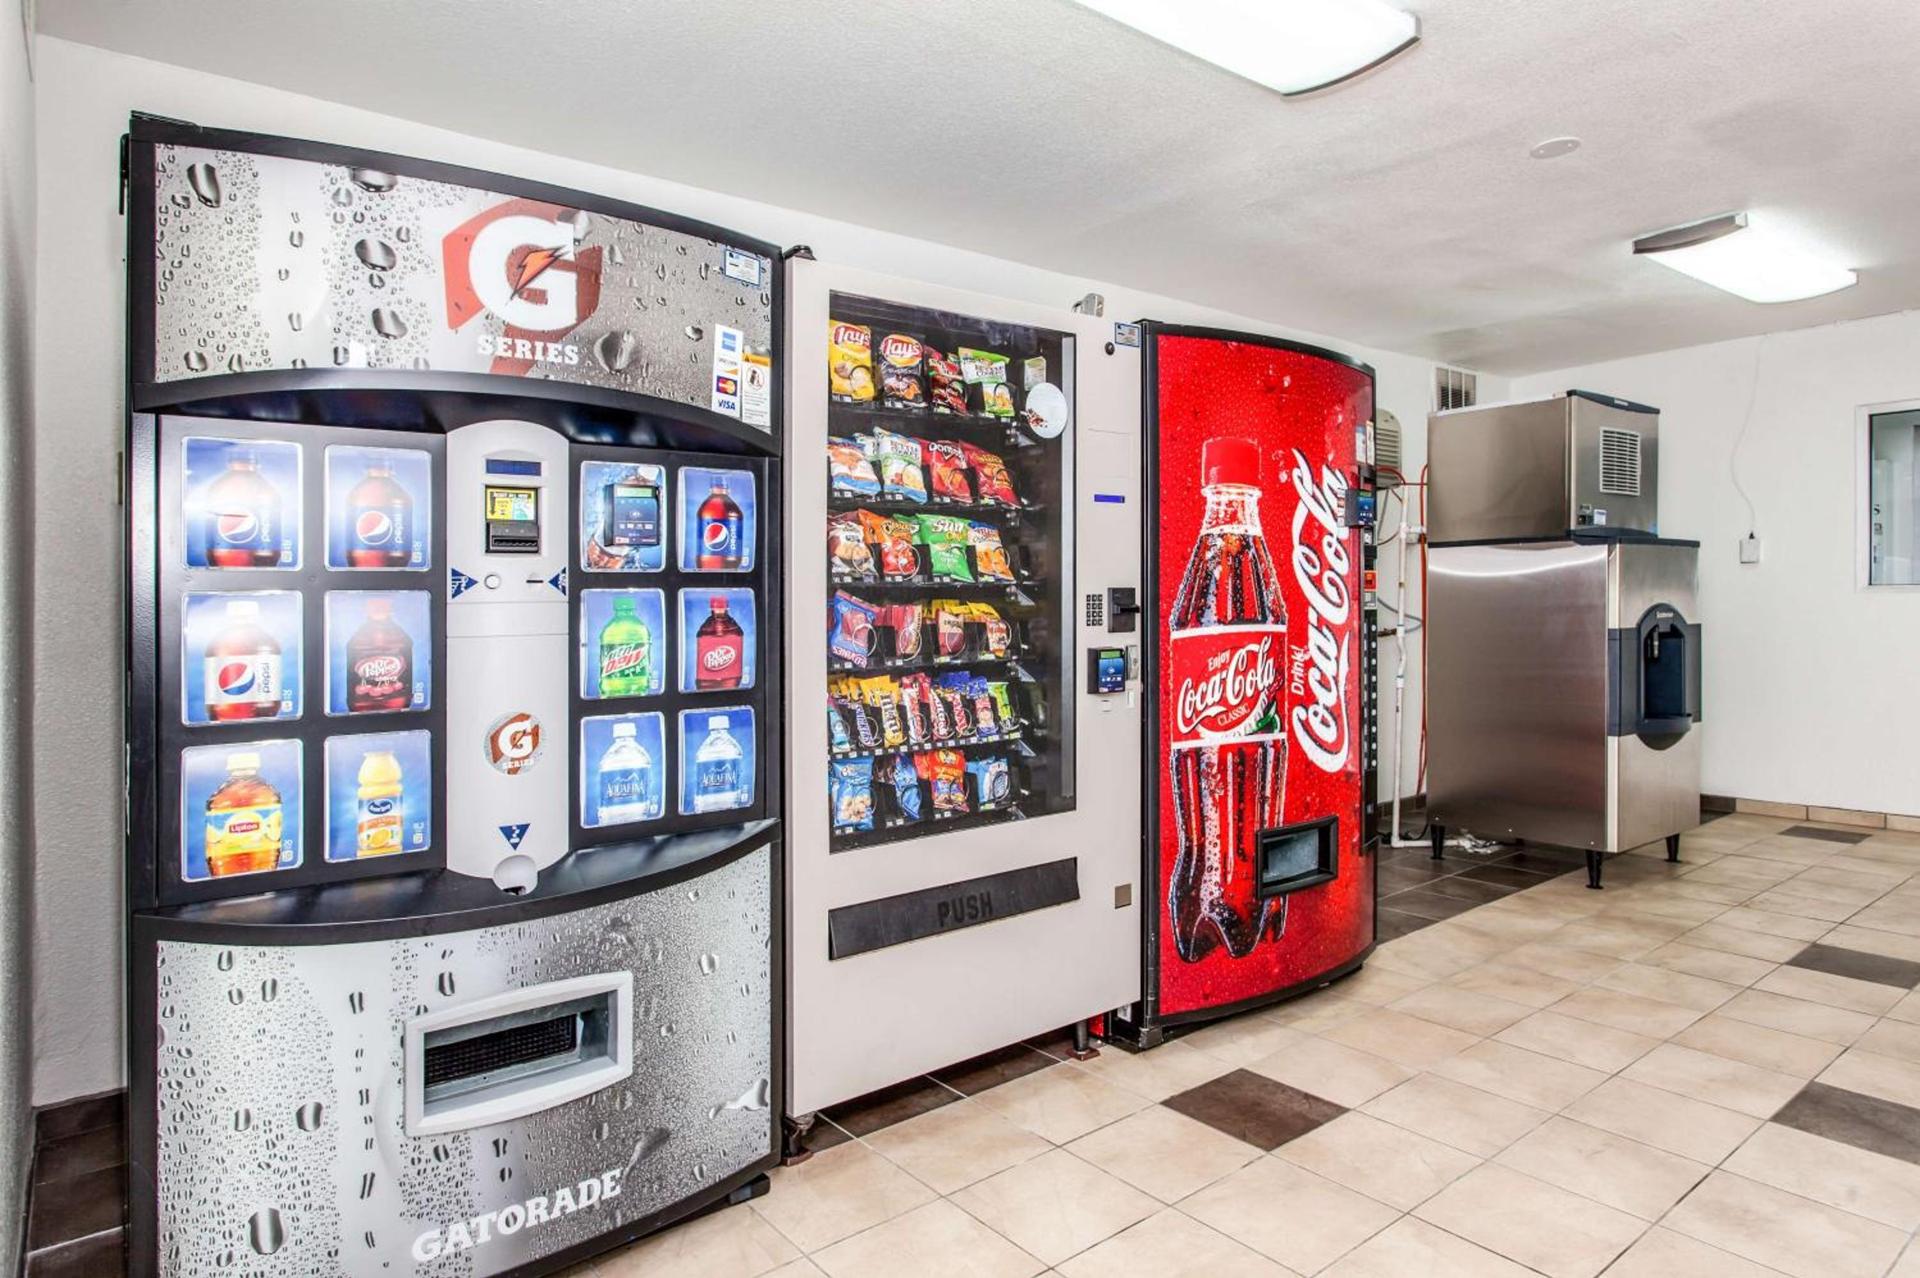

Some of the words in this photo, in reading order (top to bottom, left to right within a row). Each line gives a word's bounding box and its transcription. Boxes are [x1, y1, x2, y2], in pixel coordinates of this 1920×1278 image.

[468, 214, 579, 332] G
[477, 334, 580, 366] SERIES
[717, 399, 737, 411] VISA
[394, 513, 404, 544] pepsi
[1291, 447, 1351, 774] Coca-Cola
[1207, 649, 1231, 672] Enjoy
[261, 662, 272, 694] pepsi
[1177, 635, 1276, 735] Coca-Cola
[1216, 703, 1252, 727] CLASSIC
[230, 822, 259, 832] Lipton
[937, 891, 993, 928] PUSH
[411, 1167, 625, 1263] GATORADE
